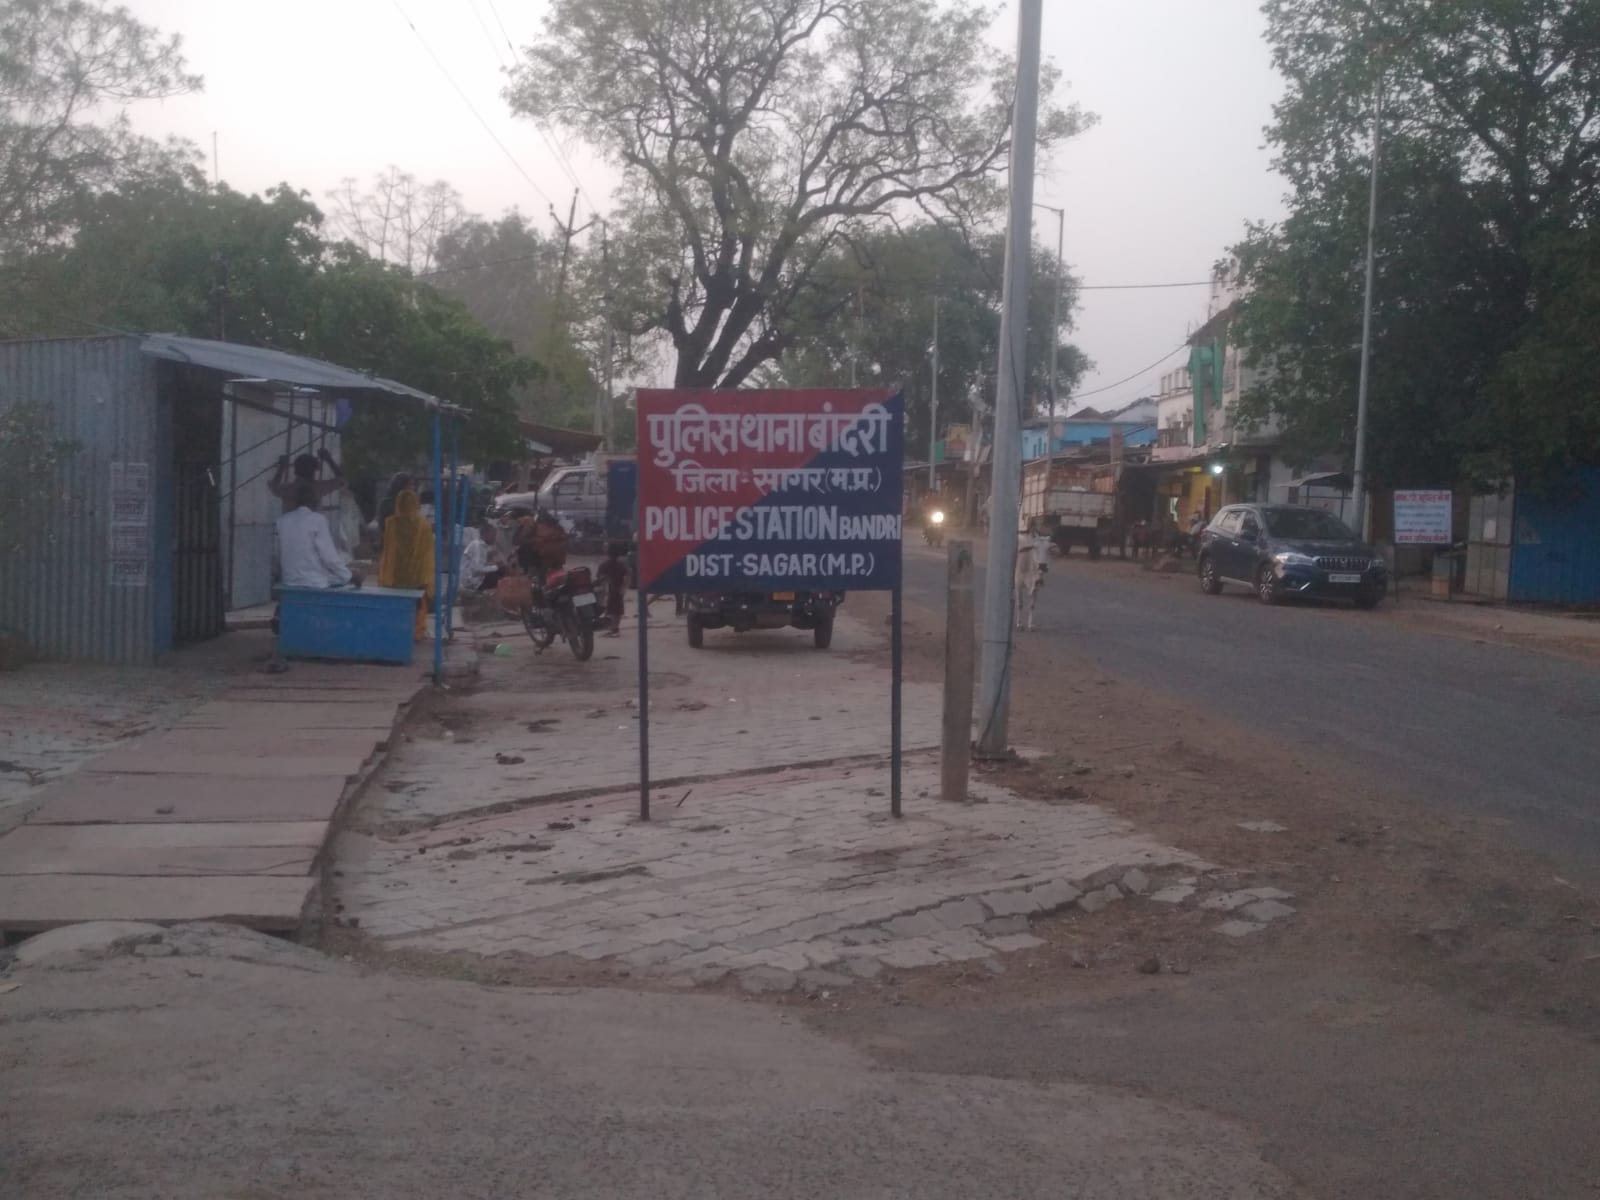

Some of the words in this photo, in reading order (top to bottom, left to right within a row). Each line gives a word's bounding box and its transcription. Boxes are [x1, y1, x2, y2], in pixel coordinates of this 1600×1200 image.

[807, 401, 893, 457] बांदरी
[645, 505, 734, 541] POLICE
[735, 505, 838, 541] STATION
[839, 514, 902, 541] BANDRI
[686, 553, 734, 577] DIST
